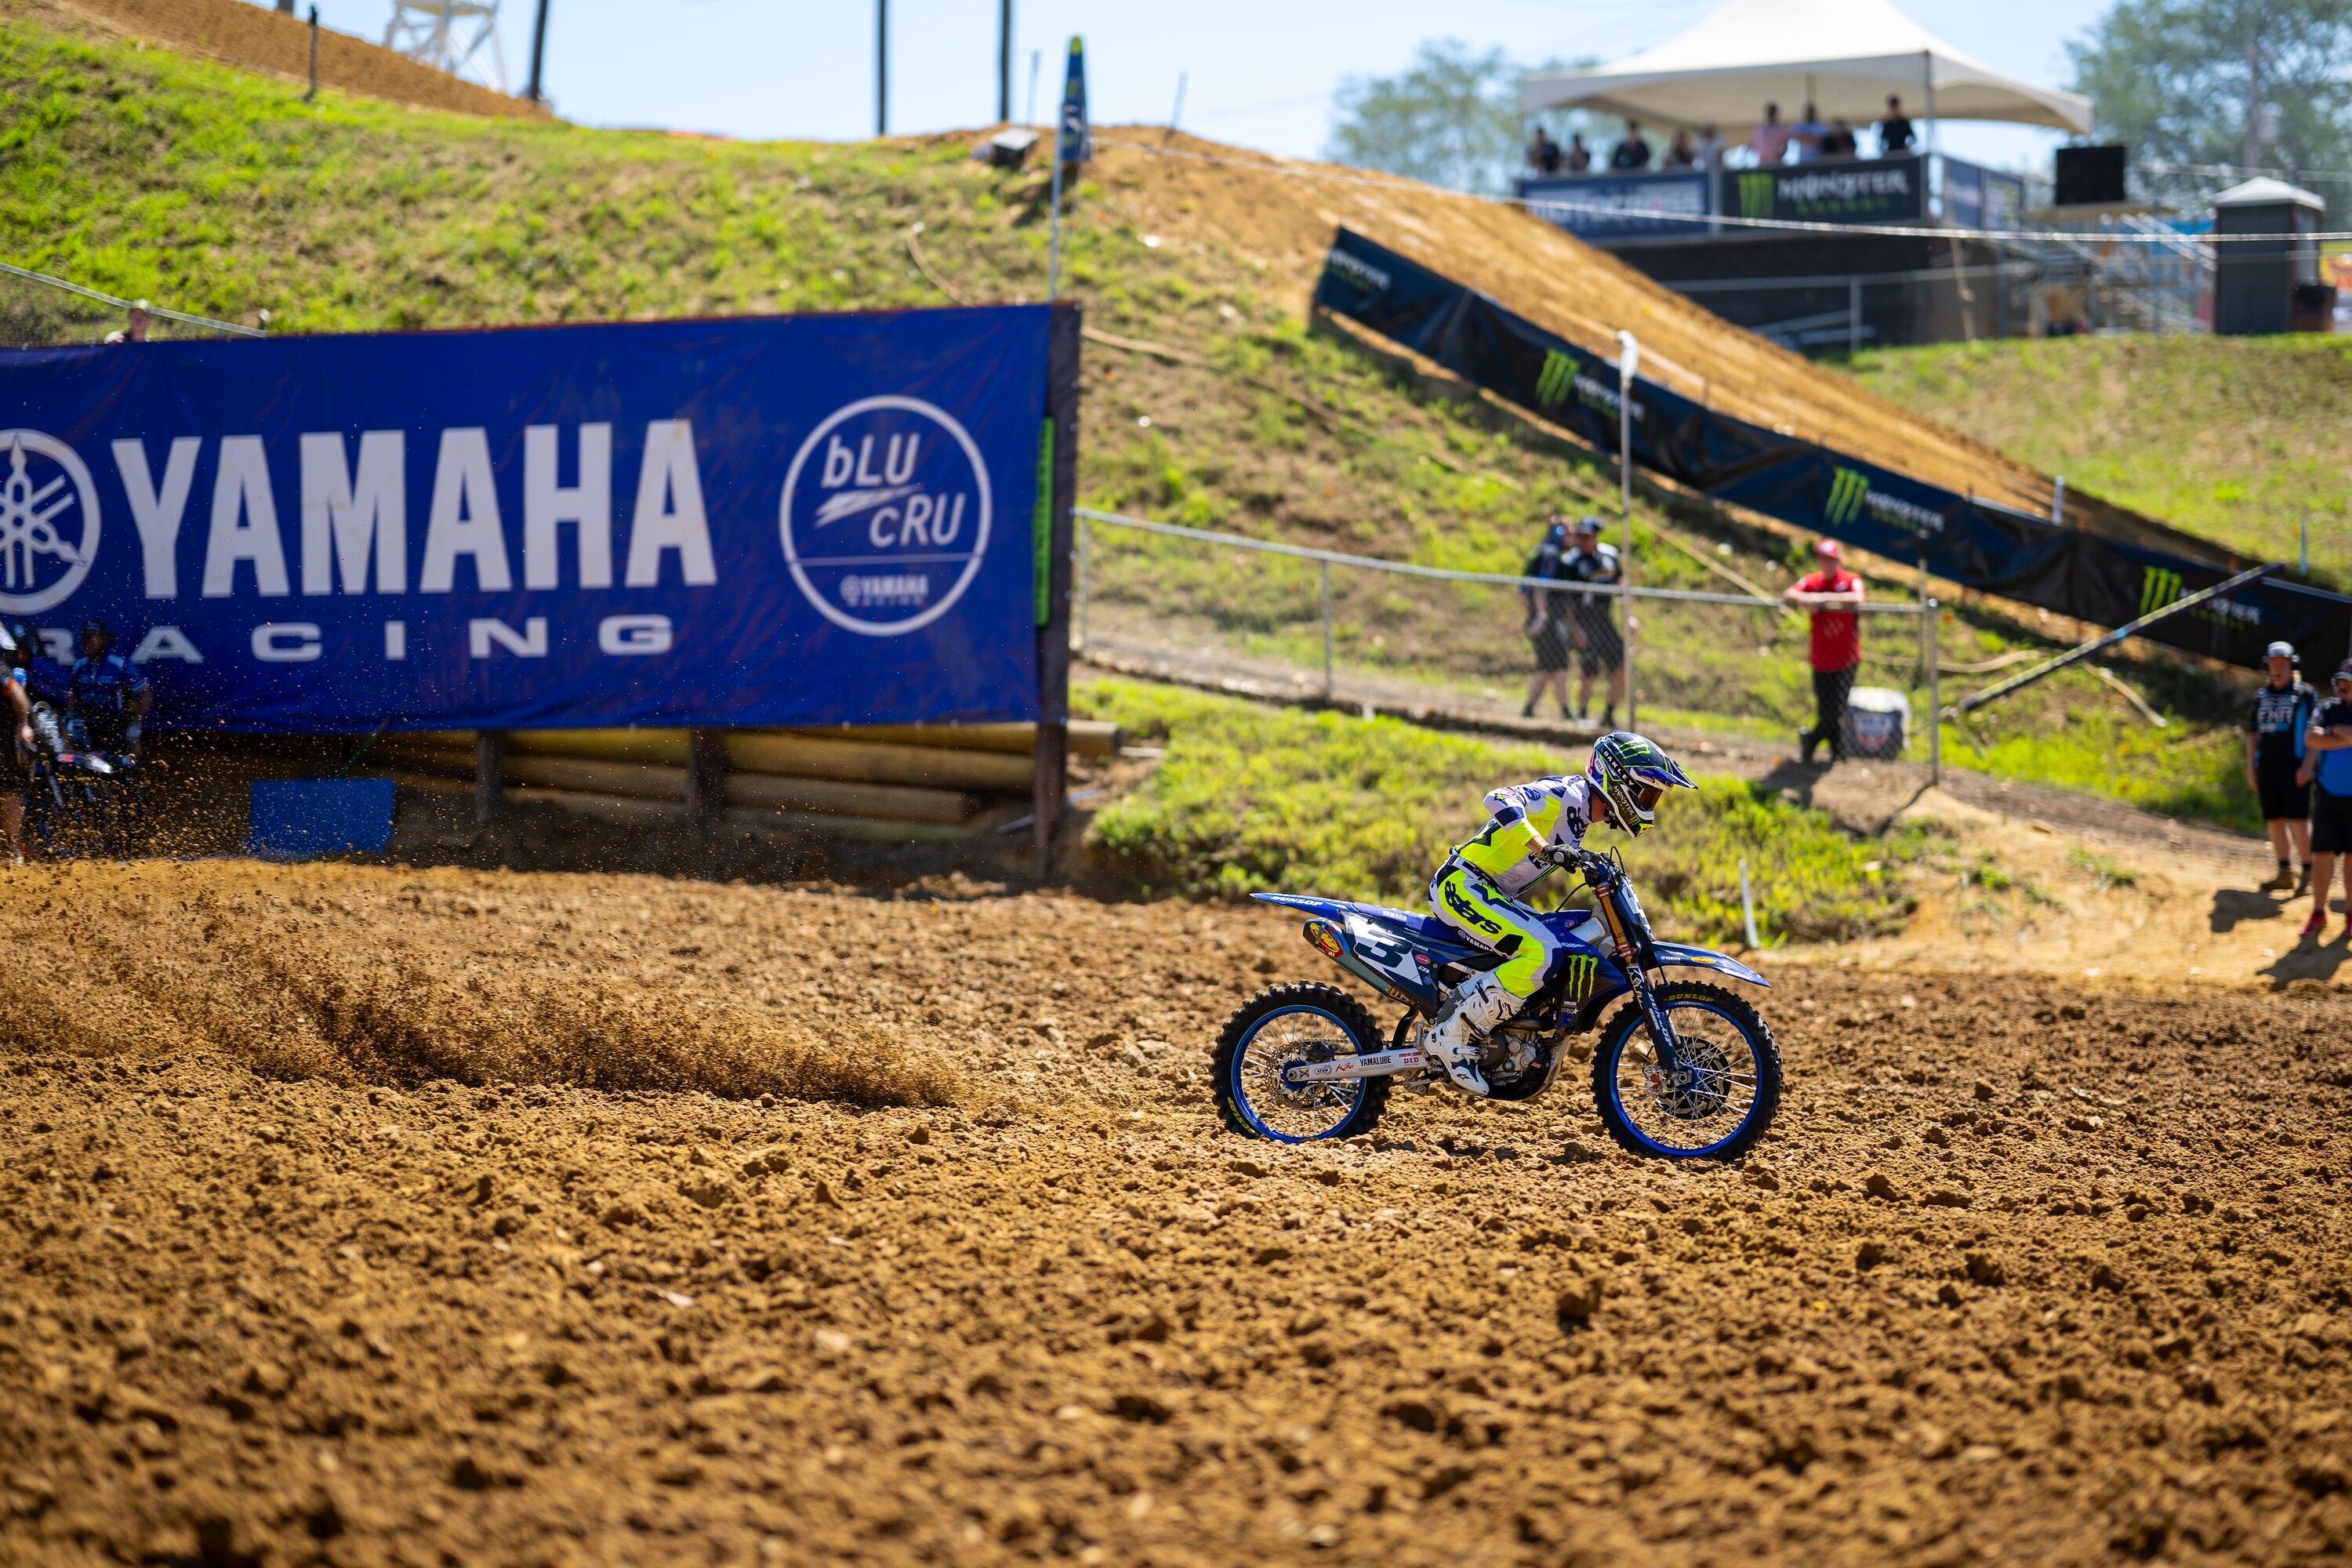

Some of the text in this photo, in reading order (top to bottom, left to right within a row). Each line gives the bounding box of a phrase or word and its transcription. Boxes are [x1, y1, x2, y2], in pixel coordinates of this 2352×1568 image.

[111, 419, 717, 599] YAMAHA
[862, 575, 928, 597] YAMAHA
[1595, 760, 1604, 772] BELL
[1603, 751, 1635, 786] OAKLEY
[1613, 786, 1635, 815] MONSTER
[1269, 896, 1324, 906] DUNLOP
[1382, 910, 1407, 922] YAMAHA
[1354, 929, 1413, 968] 3
[1668, 993, 1715, 1003] DUNLOP
[1648, 992, 1674, 1047] DUNLOP
[1359, 1055, 1392, 1067] YAMALUBE
